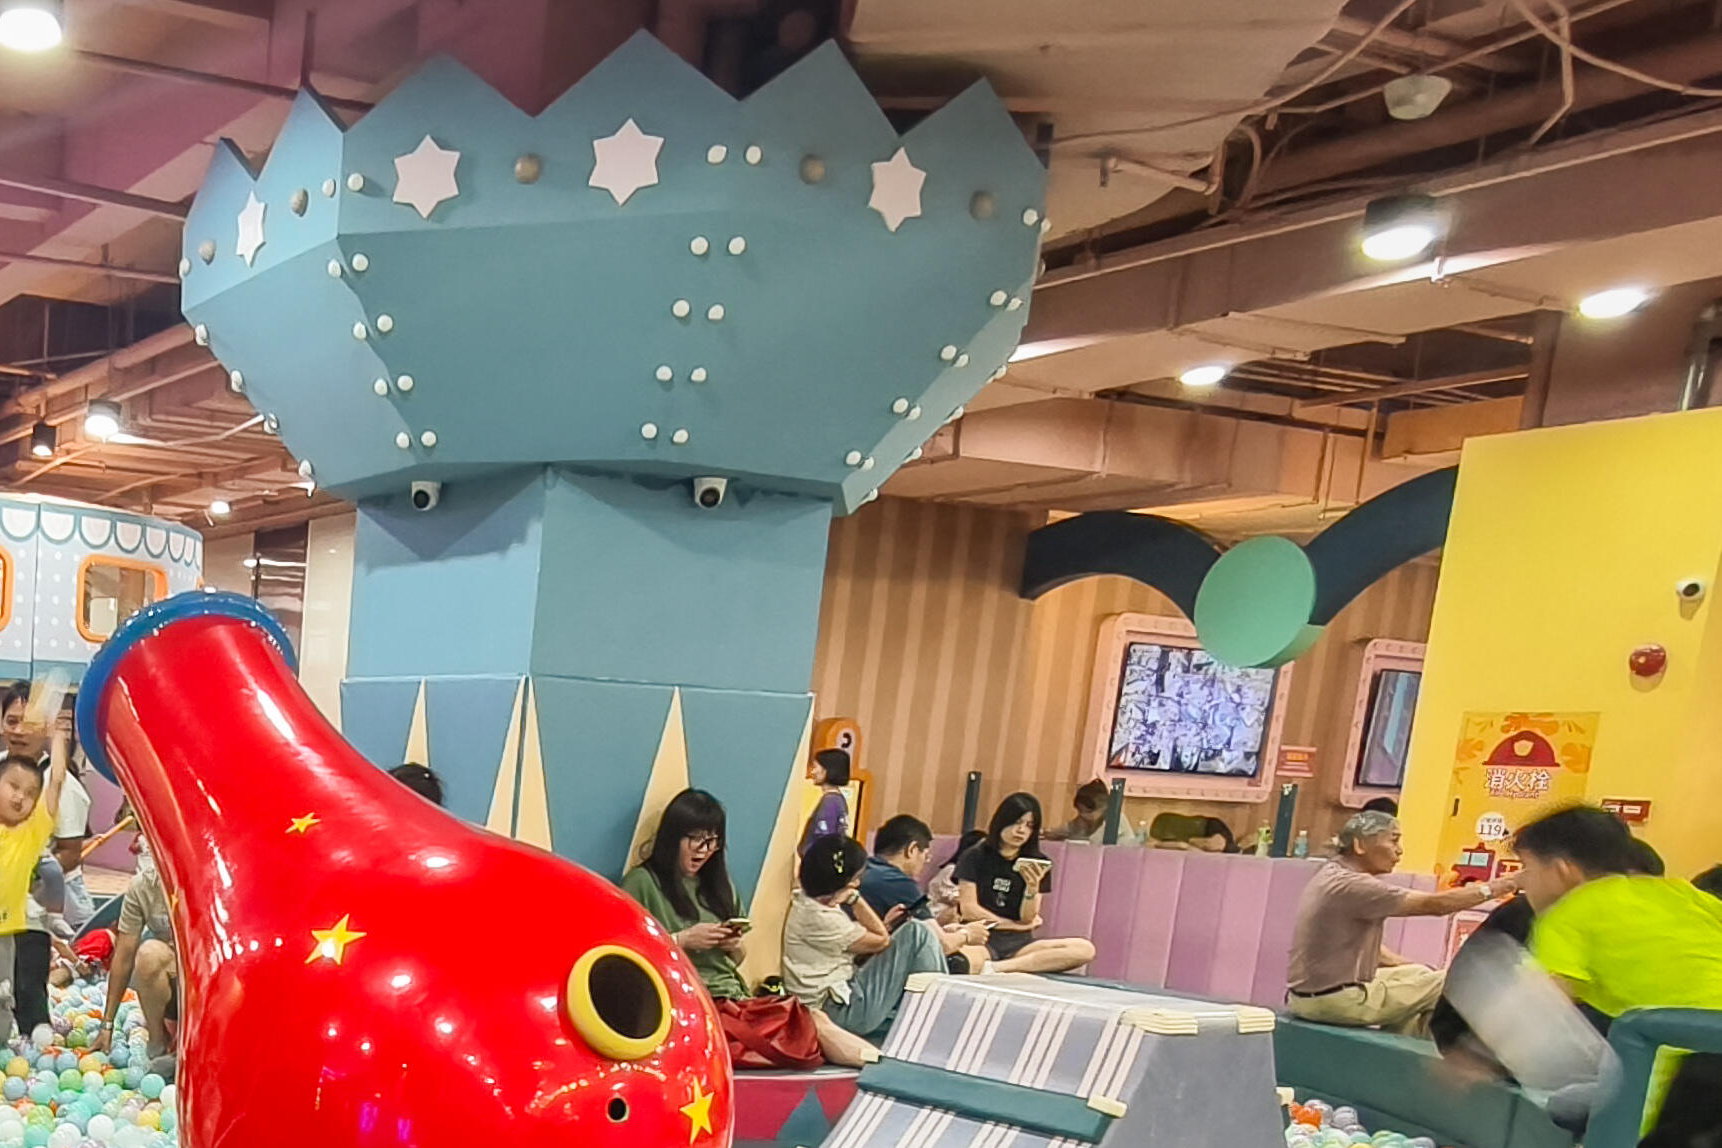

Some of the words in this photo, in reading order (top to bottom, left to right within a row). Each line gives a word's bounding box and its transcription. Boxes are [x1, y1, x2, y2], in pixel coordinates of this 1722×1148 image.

[1484, 769, 1550, 792] 消火栓
[1478, 824, 1502, 836] 119
